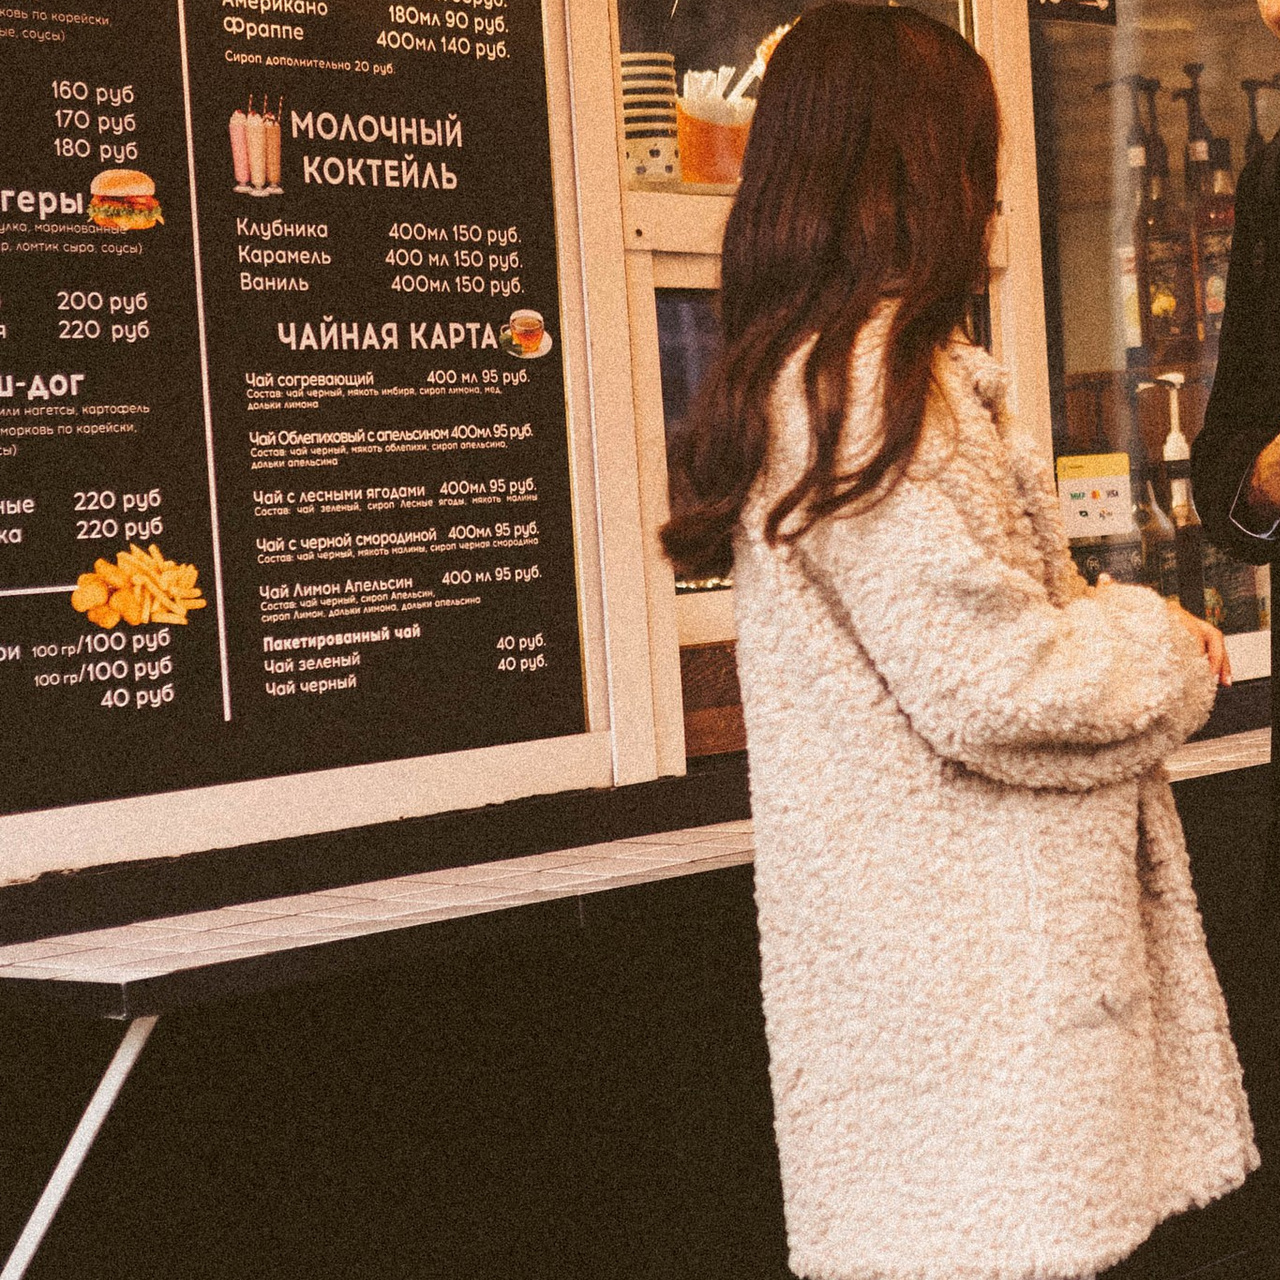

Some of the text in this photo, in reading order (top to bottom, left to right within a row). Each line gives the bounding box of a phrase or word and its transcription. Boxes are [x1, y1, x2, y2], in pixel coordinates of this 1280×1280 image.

[388, 5, 441, 27] 180мл
[445, 11, 468, 30] 90
[474, 13, 510, 35] руб.
[223, 16, 511, 61] Фраппе 400мл 140 руб.
[224, 50, 396, 76] Сироп дополнительно 20 руб.
[52, 80, 134, 107] 160 руб
[54, 109, 136, 135] 170 руб
[291, 110, 462, 148] МОЛОЧНЫЙ
[54, 138, 138, 164] 180 руб
[303, 154, 458, 190] КОКТЕЙЛЬ
[236, 218, 522, 246] Клубника 400мл 150 руб.
[16, 242, 59, 252] ломтик
[101, 243, 143, 255] соусы)
[238, 245, 524, 272] Карамель 400 мл 150 руб.
[240, 272, 525, 297] Ваниль 400мл 150 руб.
[56, 291, 148, 314] 200 руб
[58, 321, 150, 343] 220 руб
[277, 314, 499, 350] ЧАЙНАЯ КАРТА
[245, 369, 530, 389] Чай согревающий 400 мл 95 руб.
[82, 404, 150, 416] картофель
[57, 425, 73, 434] по
[249, 423, 533, 446] Чай Облепиховый с апельсином 400мл 95 руб.
[73, 489, 162, 512] 220 руб
[253, 477, 537, 505] Чай с лесными ягодами 400мл 95 руб.
[76, 517, 163, 540] 220 руб
[256, 521, 540, 552] Чай с черной смородиной 400мл 95 руб.
[260, 565, 542, 600] Чай Лимон Апельсин 400 мл 95 руб.
[31, 645, 58, 658] 100
[132, 628, 171, 652] руб
[263, 623, 421, 652] Пакетированный чай
[264, 633, 546, 674] Чай зеленый 40 руб.
[34, 673, 60, 687] 100
[134, 655, 173, 681] руб
[265, 654, 548, 696] Чай черный 40 руб.
[100, 683, 174, 709] 40 руб
